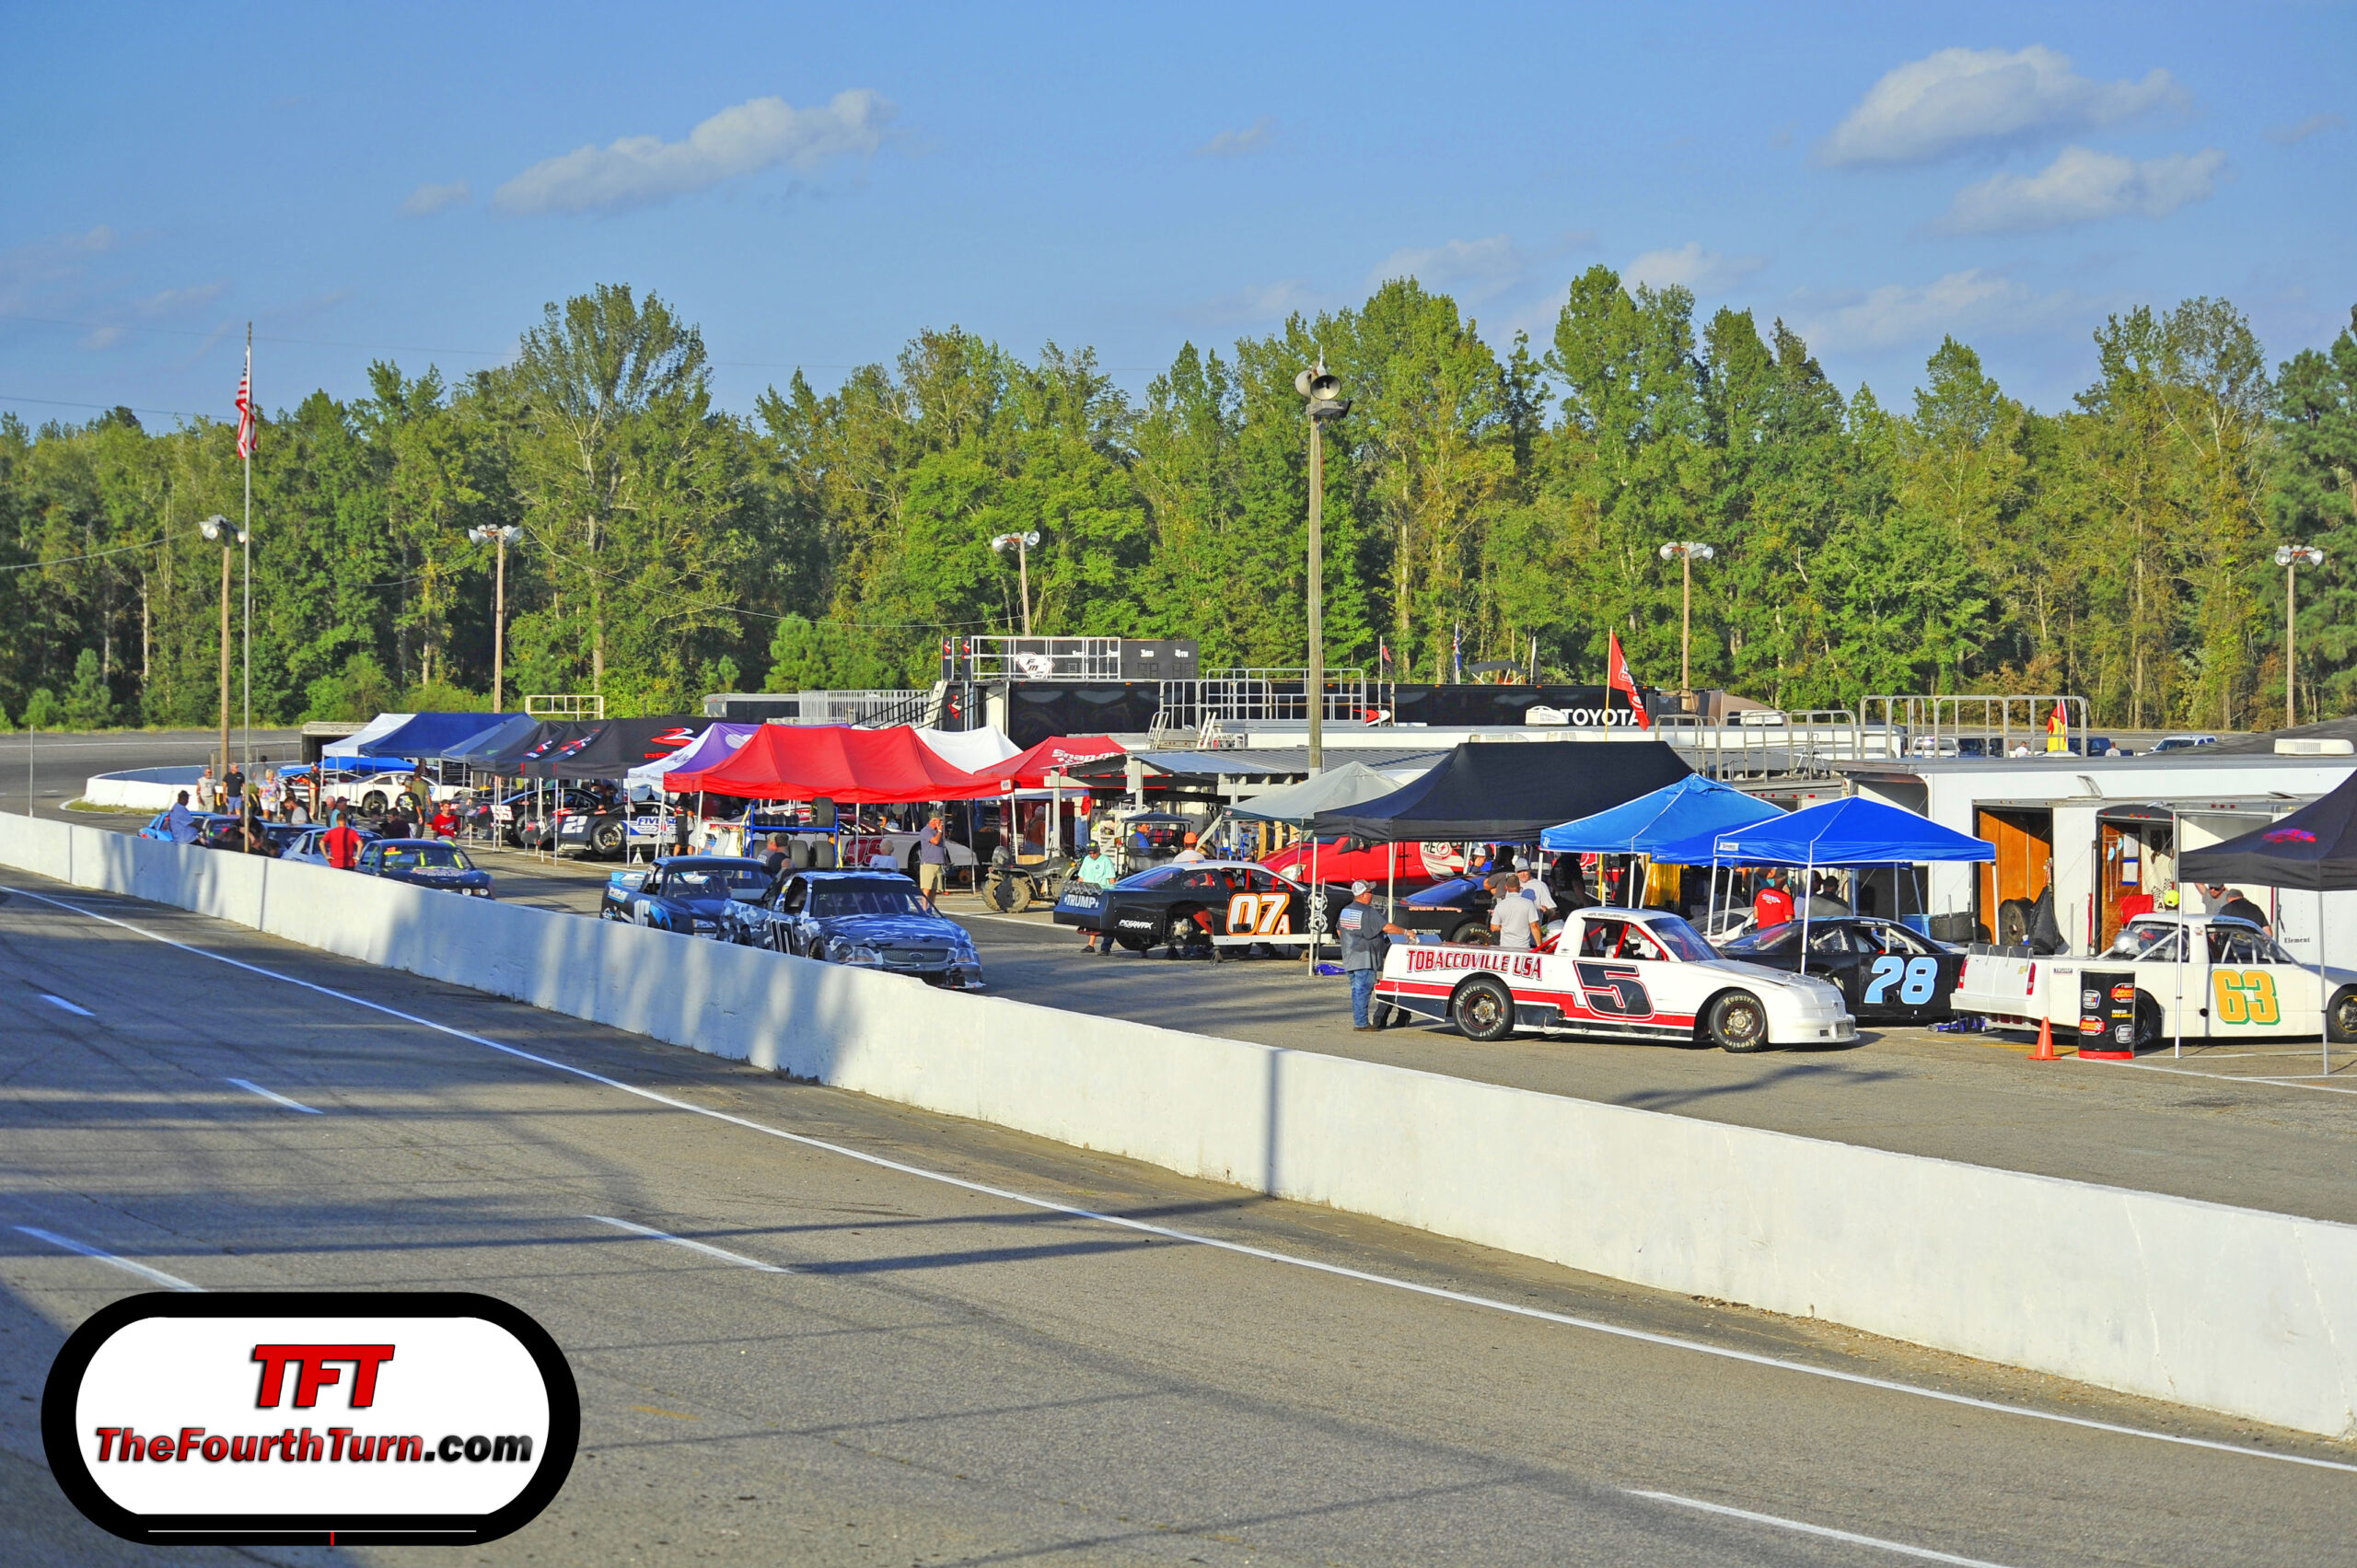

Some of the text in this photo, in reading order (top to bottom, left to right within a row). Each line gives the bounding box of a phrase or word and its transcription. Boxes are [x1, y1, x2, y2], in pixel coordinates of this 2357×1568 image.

[561, 815, 588, 834] 2
[1066, 895, 1096, 909] TRUMP
[1226, 892, 1291, 935] 07
[1274, 913, 1290, 935] A
[1406, 948, 1543, 981] TOBACCOVILLE USA
[1573, 960, 1655, 1022] 5
[1864, 956, 1938, 1005] 28
[1723, 995, 1755, 1006] Hoosier
[2211, 969, 2282, 1026] 63
[1724, 1038, 1756, 1049] Hoosier
